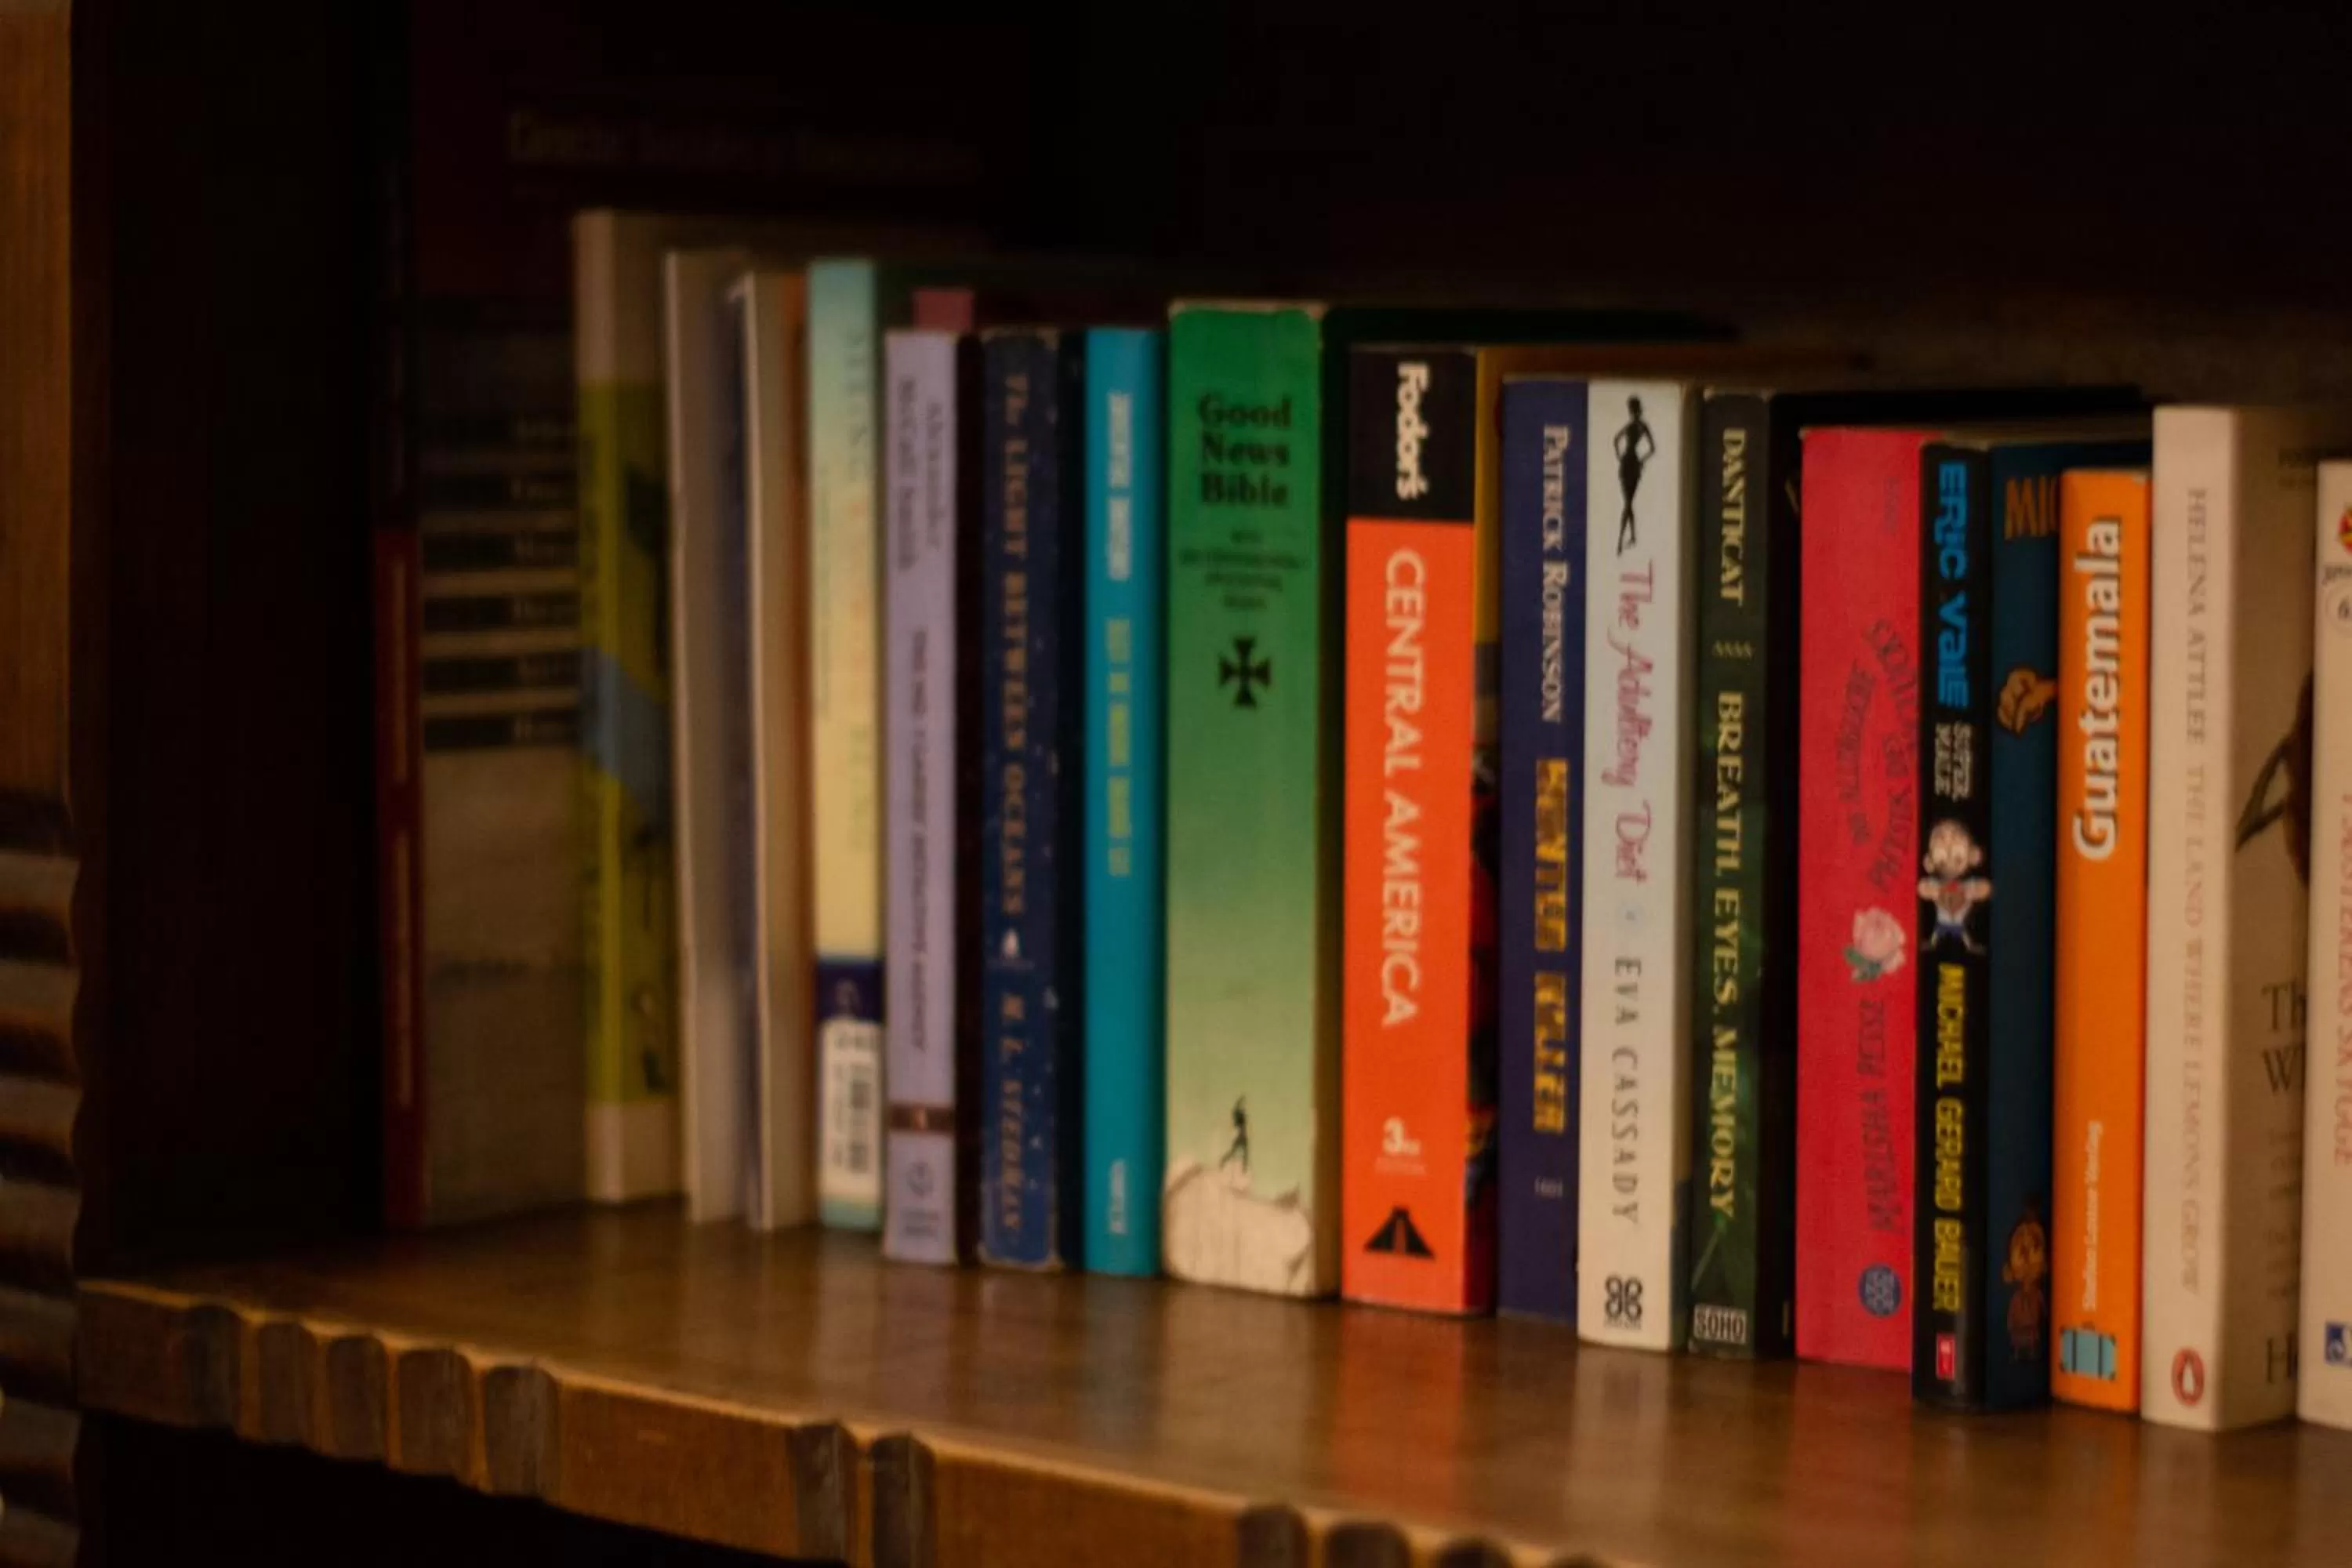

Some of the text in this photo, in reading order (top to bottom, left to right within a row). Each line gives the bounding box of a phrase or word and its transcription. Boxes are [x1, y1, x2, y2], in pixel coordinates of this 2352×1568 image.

[1198, 394, 1292, 427] Good
[1201, 431, 1290, 466] News
[1201, 474, 1289, 505] Bible
[1719, 427, 1747, 607] DANTICAT
[1932, 460, 1970, 582] ERIC
[1541, 425, 1569, 723] PATRICK ROBINSON
[2184, 488, 2207, 745] HELENA ATTLEE
[1380, 549, 1426, 1027] CENTRAL AMERICA
[1602, 564, 1653, 885] The Adultery Diet
[2072, 517, 2119, 861] Guatemala
[1610, 956, 1642, 1225] EVA CASSADY
[1708, 1023, 1737, 1218] MEMORY
[1931, 961, 1968, 1313] MICHAEL GERARD BAUER
[1693, 1305, 1746, 1344] SOHO
